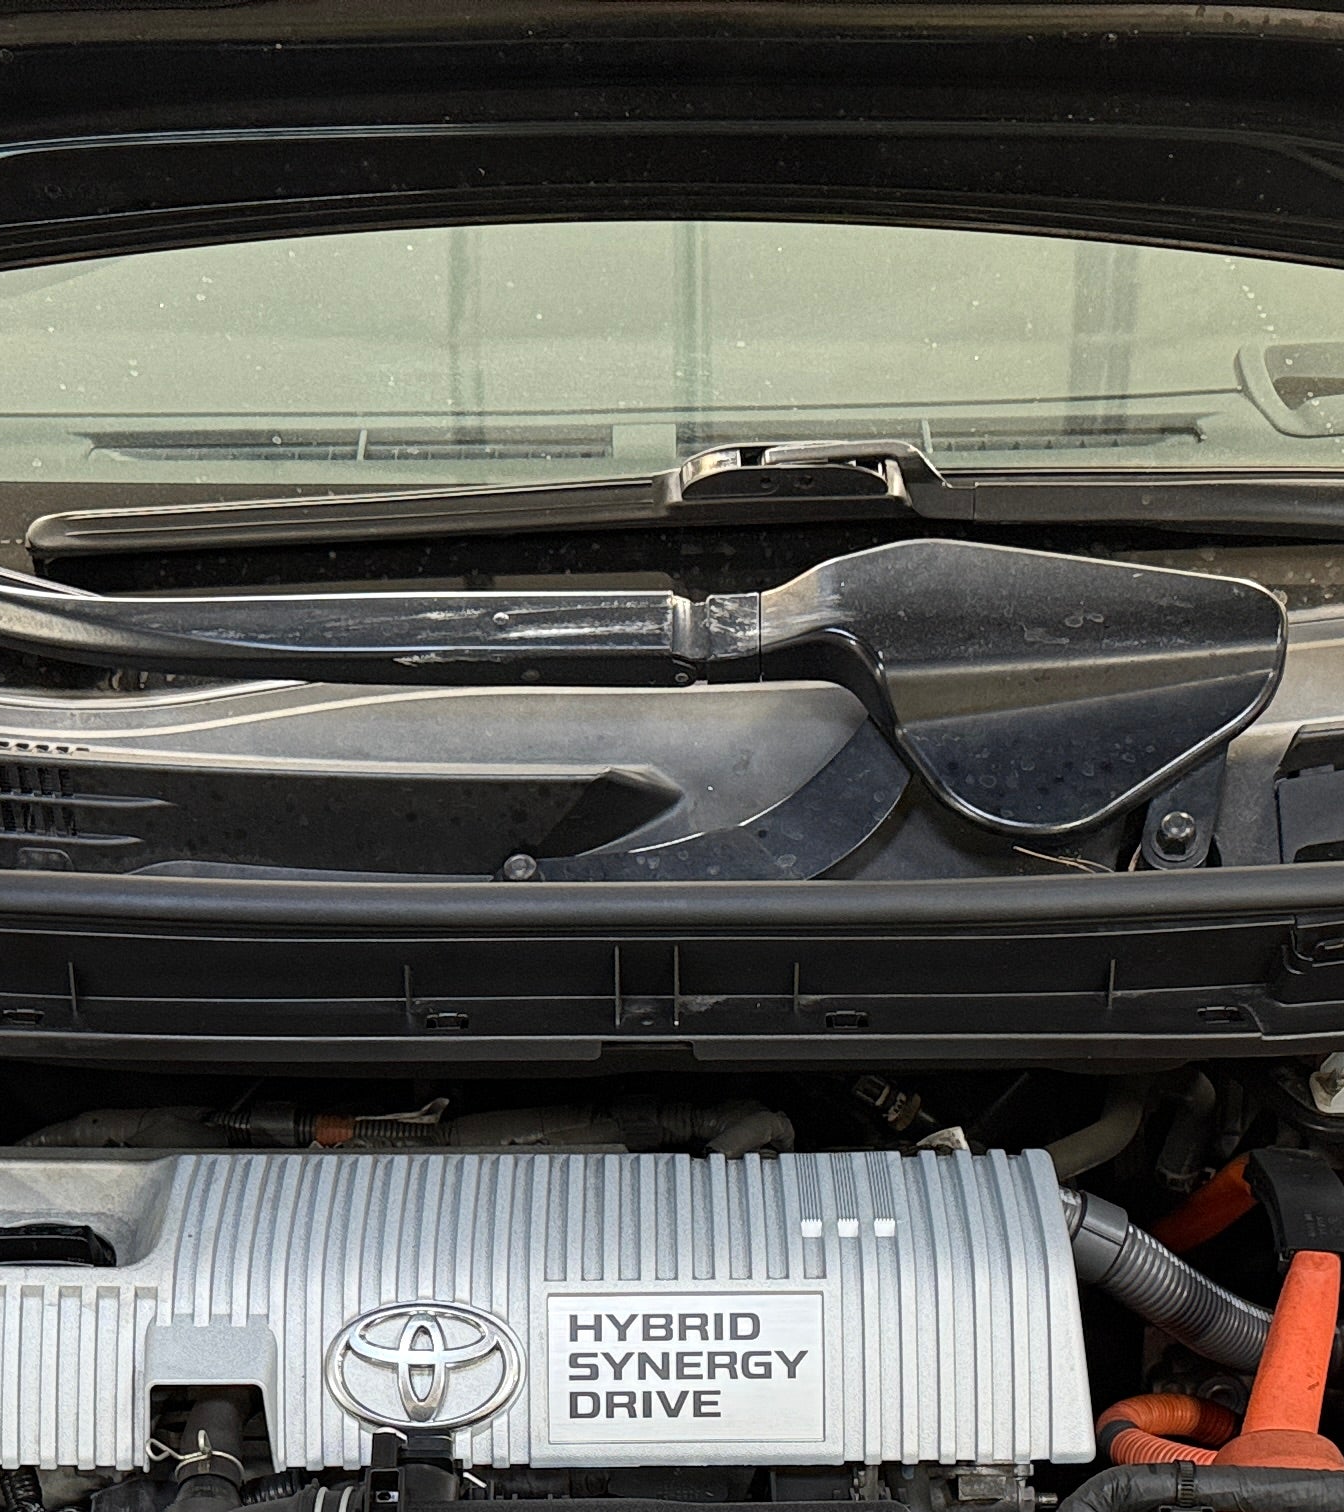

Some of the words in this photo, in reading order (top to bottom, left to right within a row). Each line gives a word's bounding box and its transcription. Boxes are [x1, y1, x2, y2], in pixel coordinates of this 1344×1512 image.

[569, 1313, 760, 1342] HYBRID
[568, 1351, 808, 1381] SYNERGY
[569, 1390, 721, 1418] DRIVE
